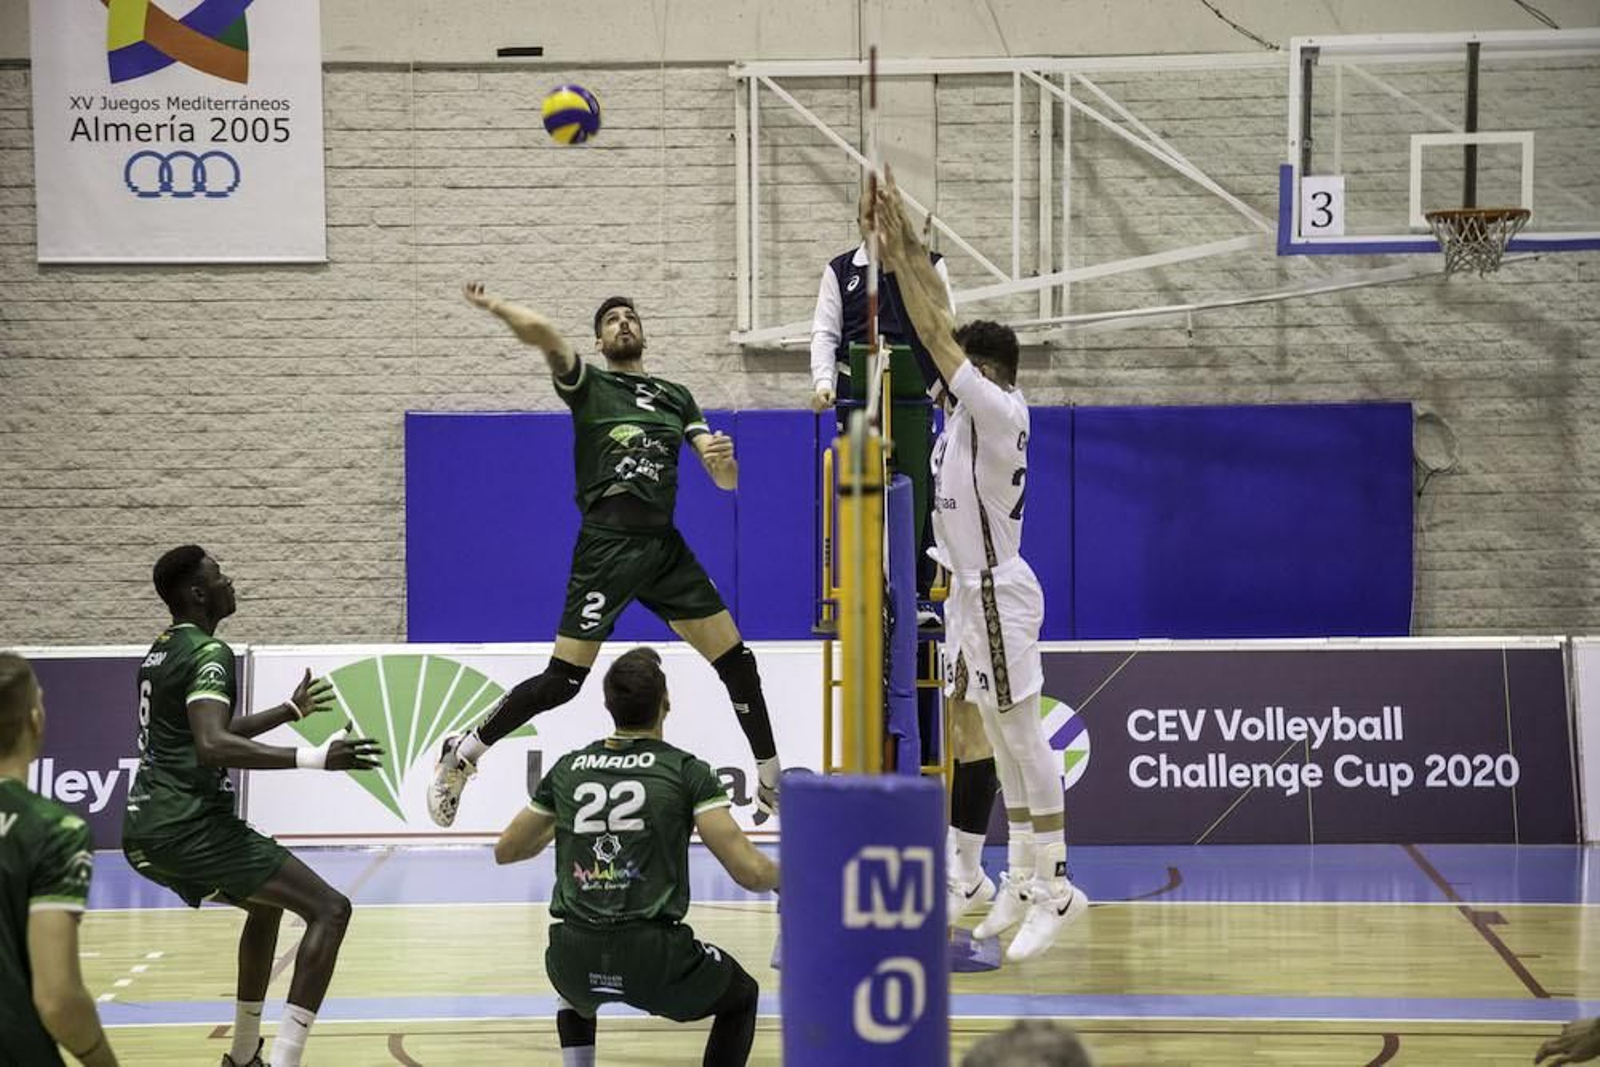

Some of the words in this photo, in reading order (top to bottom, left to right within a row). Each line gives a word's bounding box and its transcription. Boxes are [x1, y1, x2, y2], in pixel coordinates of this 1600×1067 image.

[69, 96, 94, 110] XV
[100, 96, 160, 114] Juegos
[166, 95, 291, 111] Mediterráneos
[69, 114, 195, 142] Almería
[210, 117, 291, 143] 2005
[1311, 191, 1333, 228] 3
[581, 591, 606, 619] 2
[139, 679, 152, 727] 6
[1126, 708, 1206, 742] CEV
[1213, 706, 1404, 749] Volleyball
[570, 752, 656, 771] AMADO
[1128, 752, 1324, 797] Challenge
[1333, 753, 1415, 796] Cup
[1424, 753, 1521, 788] 2020
[573, 780, 646, 834] 22
